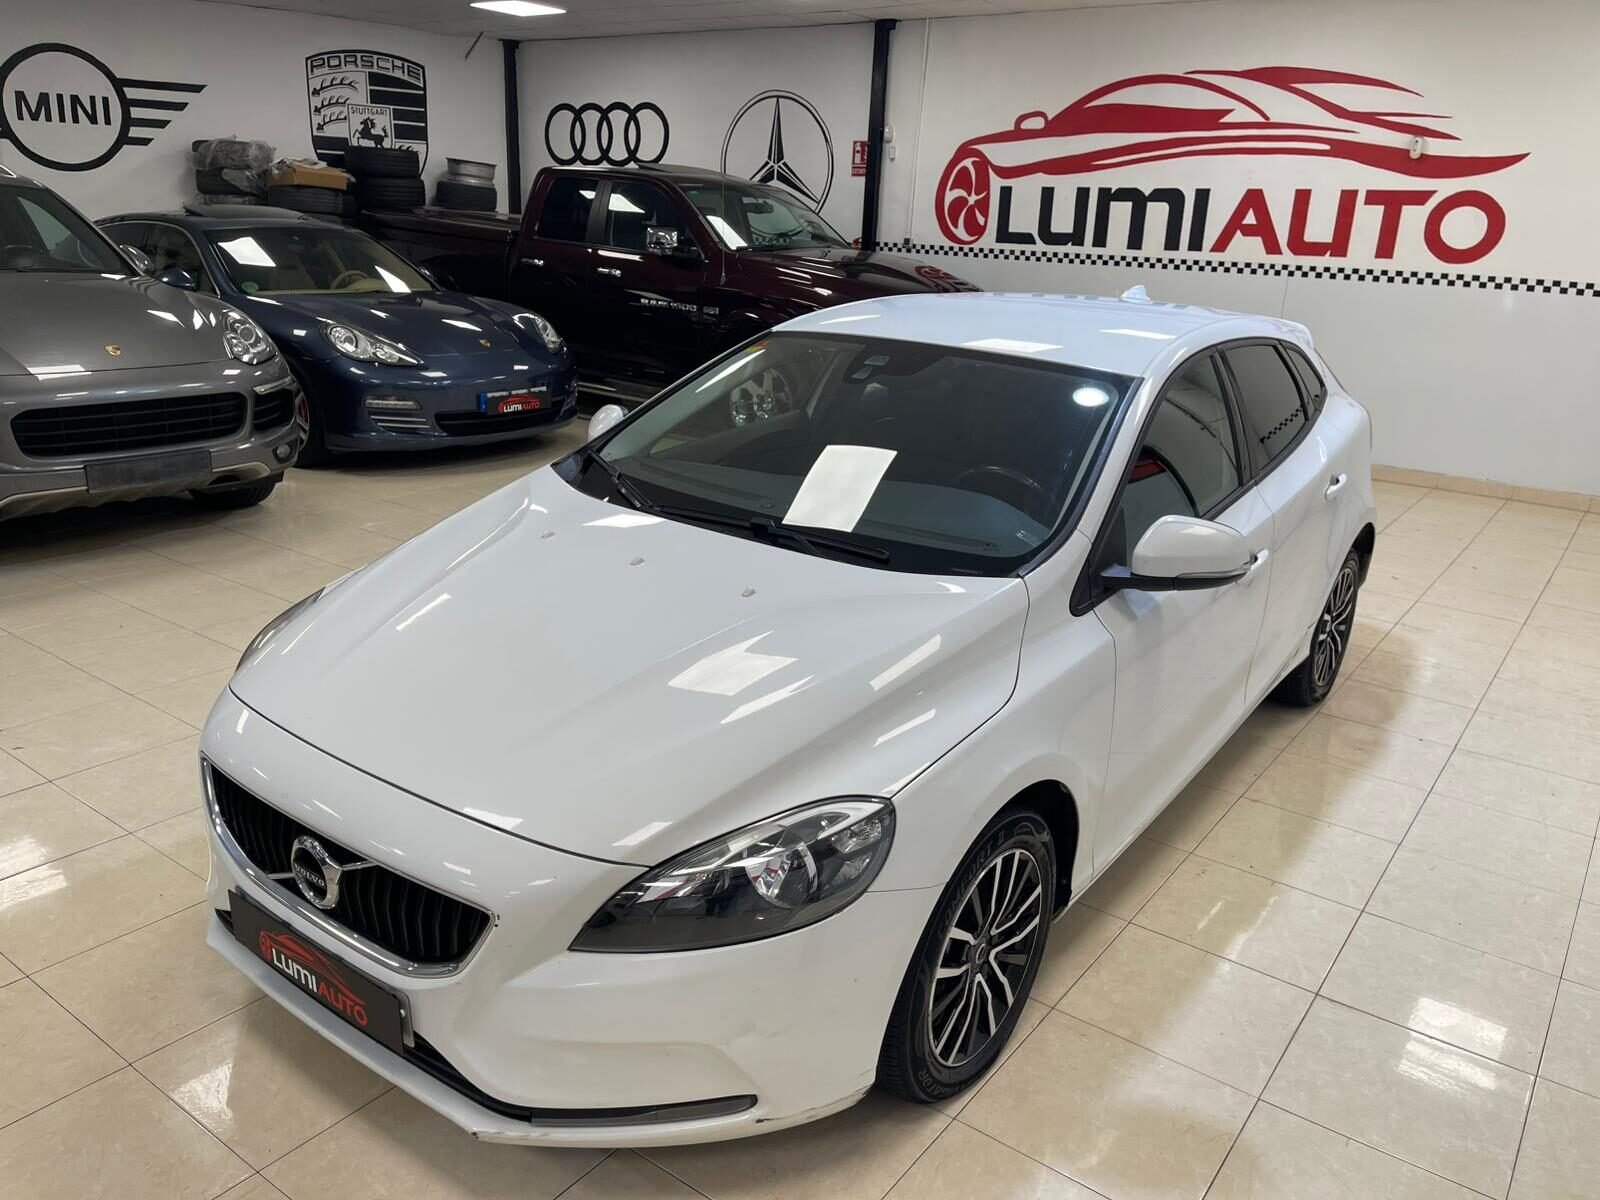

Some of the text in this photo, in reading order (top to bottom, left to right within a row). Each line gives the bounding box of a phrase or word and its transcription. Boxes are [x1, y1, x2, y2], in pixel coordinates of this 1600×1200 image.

[310, 54, 422, 82] PORSCHE
[14, 90, 112, 126] MINI
[350, 106, 388, 116] STUTTGART
[293, 862, 325, 887] VOLVO
